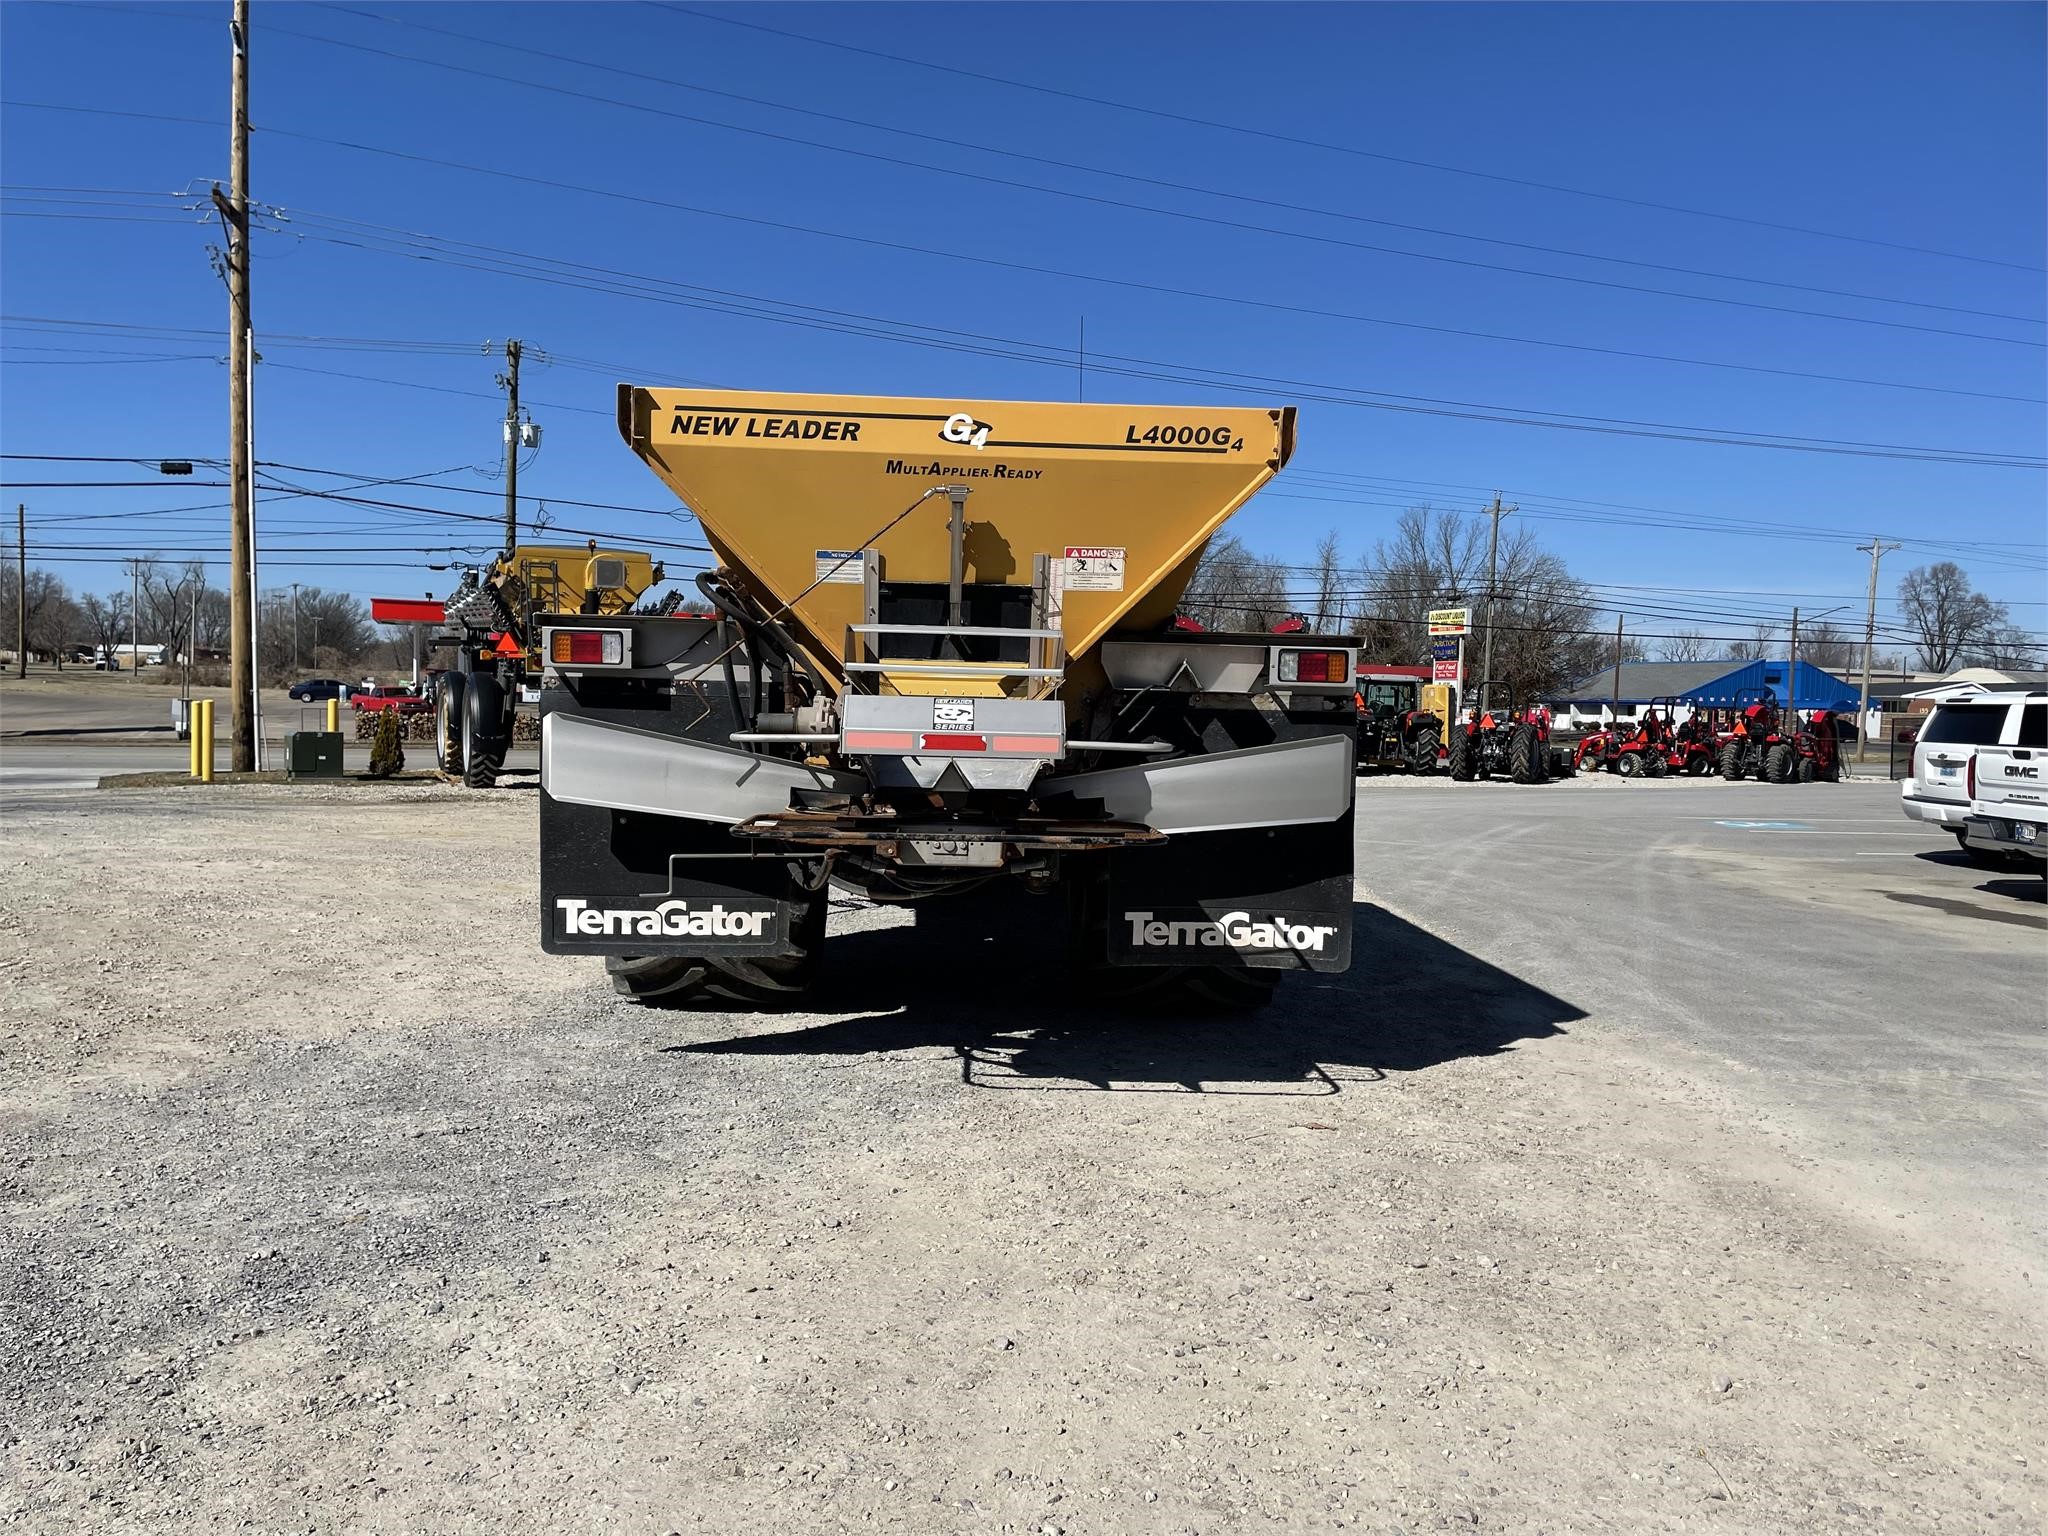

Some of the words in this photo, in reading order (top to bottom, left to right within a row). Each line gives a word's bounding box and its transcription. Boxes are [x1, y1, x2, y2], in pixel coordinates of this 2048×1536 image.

[670, 415, 740, 436] NEW
[745, 418, 861, 441] LEADER
[1125, 425, 1244, 451] L4000G4
[934, 723, 973, 731] SERIES
[2004, 765, 2039, 779] GMC
[556, 899, 772, 936] TerraGator
[1124, 911, 1334, 951] TerraGator
